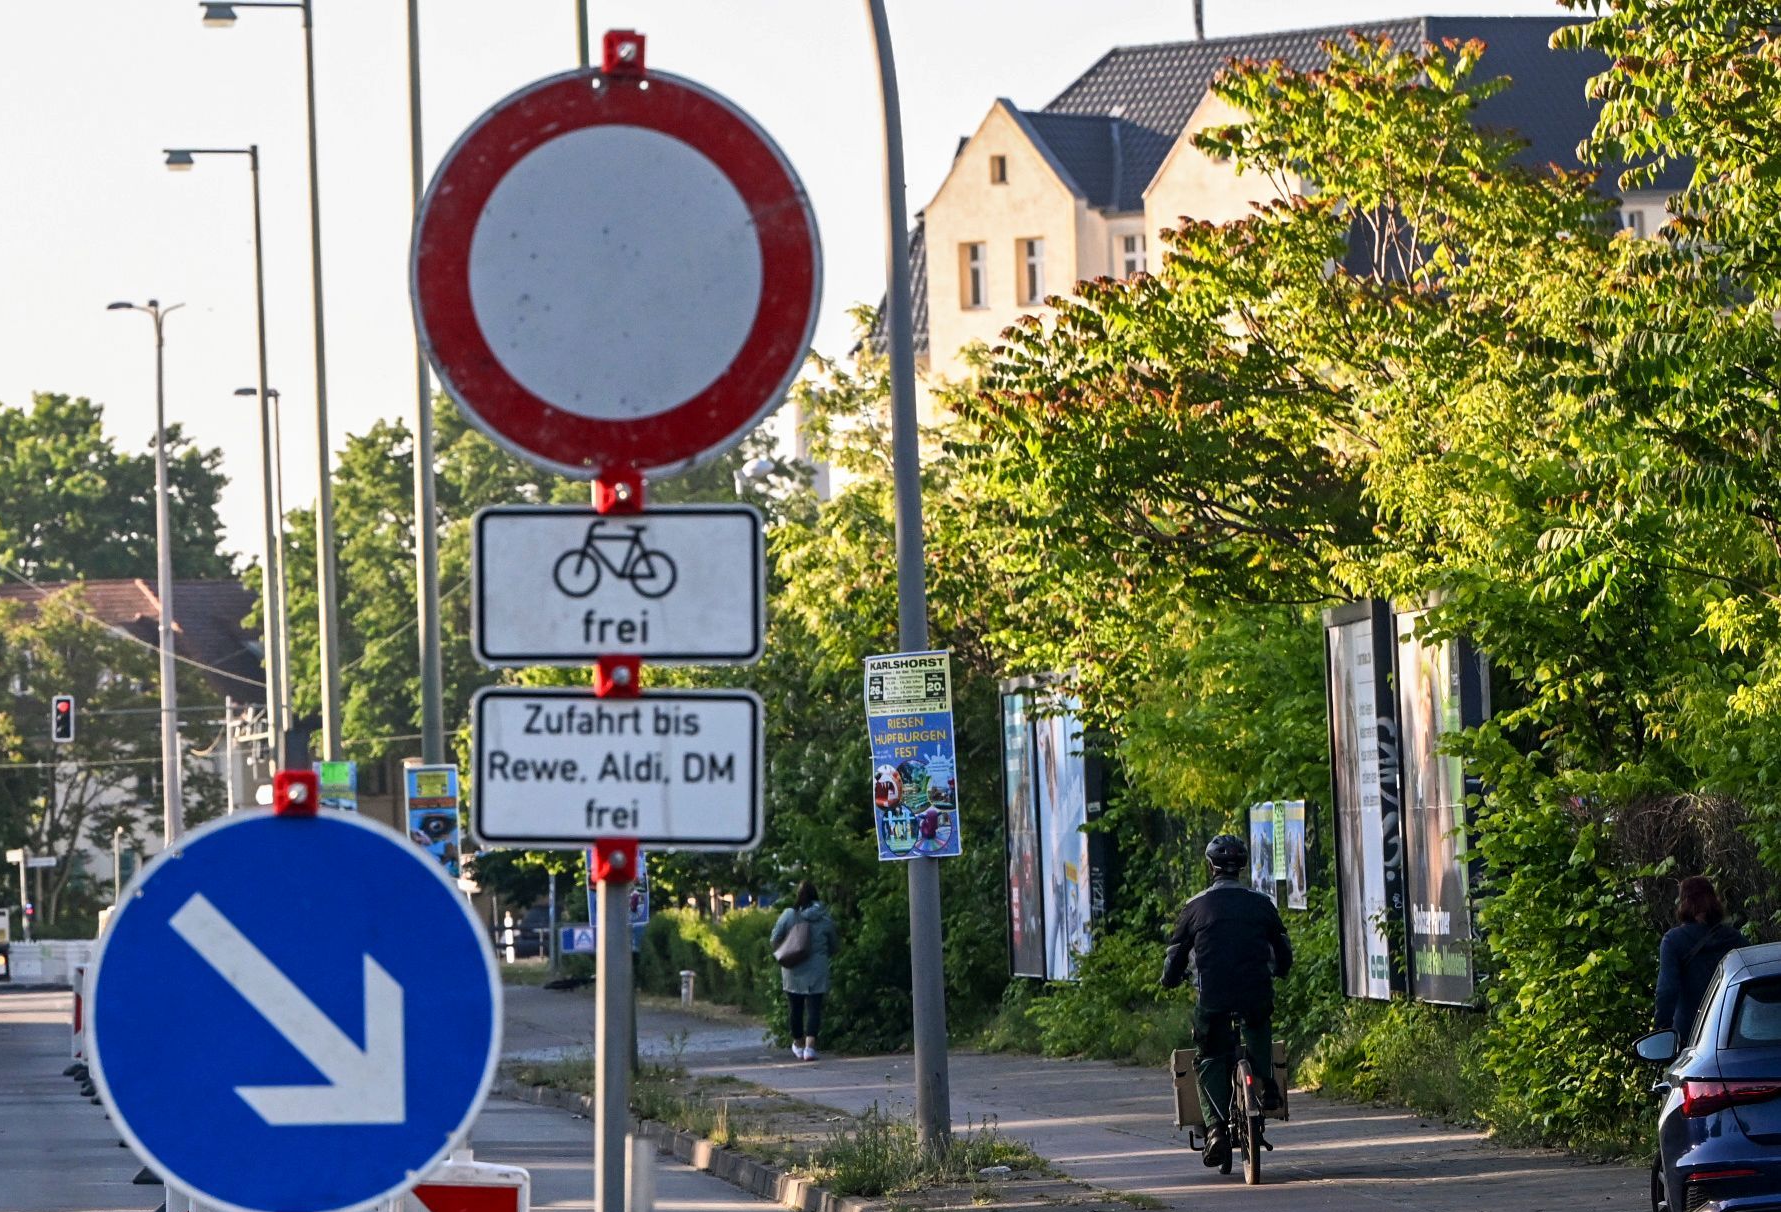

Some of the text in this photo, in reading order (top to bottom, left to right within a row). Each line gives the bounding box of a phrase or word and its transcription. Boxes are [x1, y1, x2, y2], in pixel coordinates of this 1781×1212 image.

[583, 610, 649, 644] frei
[870, 657, 945, 670] KARLSHORST
[523, 703, 701, 736] Zufahrt bis
[887, 716, 924, 729] RIESEN
[874, 729, 947, 745] HÜPFBURGEN
[894, 745, 919, 759] FEST
[683, 752, 736, 783] DM
[585, 799, 639, 830] frei
